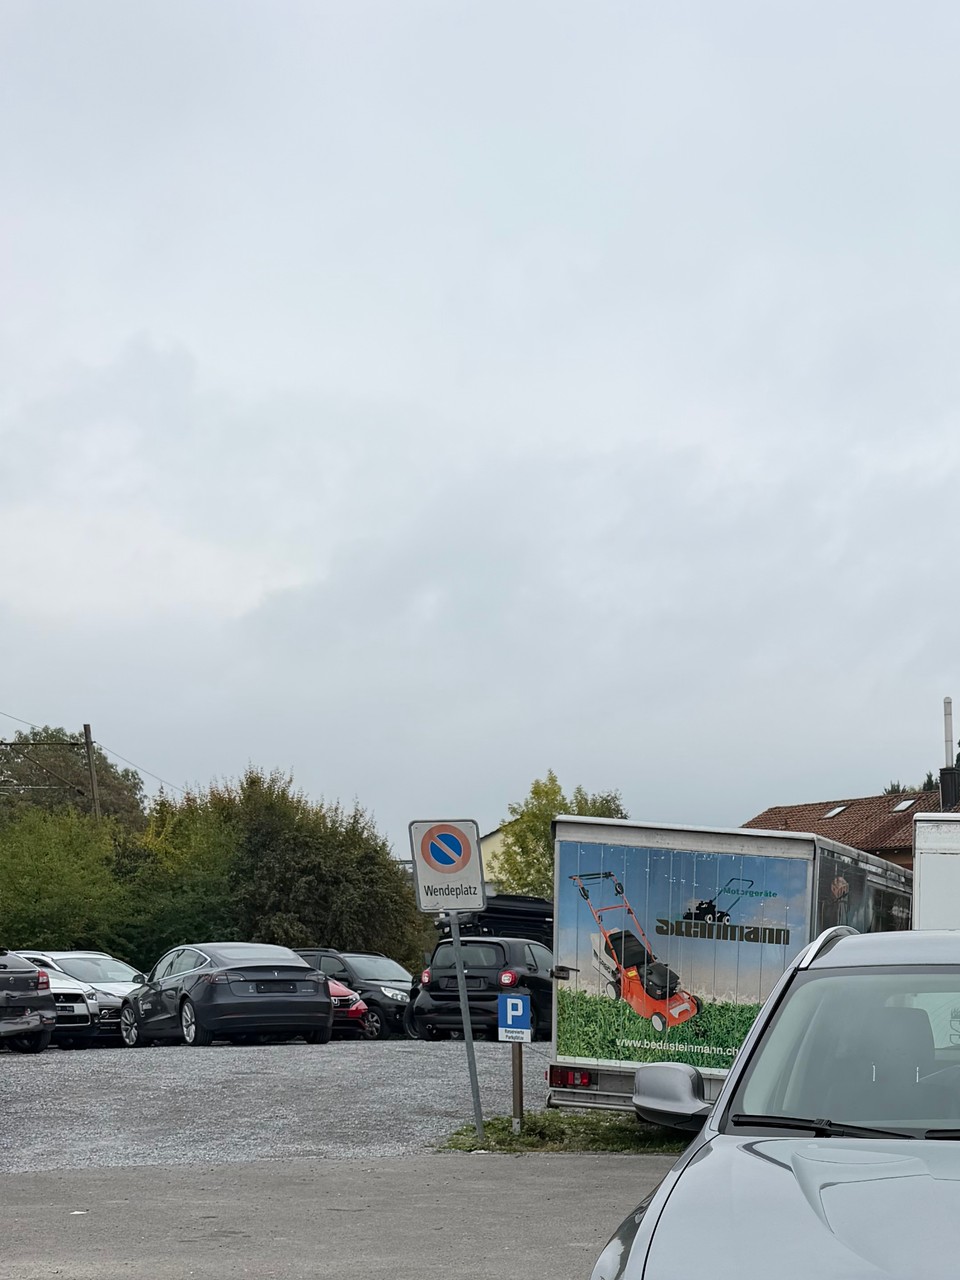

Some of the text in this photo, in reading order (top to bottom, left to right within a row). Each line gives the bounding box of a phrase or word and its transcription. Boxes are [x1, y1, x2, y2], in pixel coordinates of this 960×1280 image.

[423, 883, 478, 899] Wendeplatz
[723, 886, 778, 898] Motorgeräte
[506, 998, 523, 1025] P
[615, 1038, 740, 1057] www.bedasteinmann.ch
